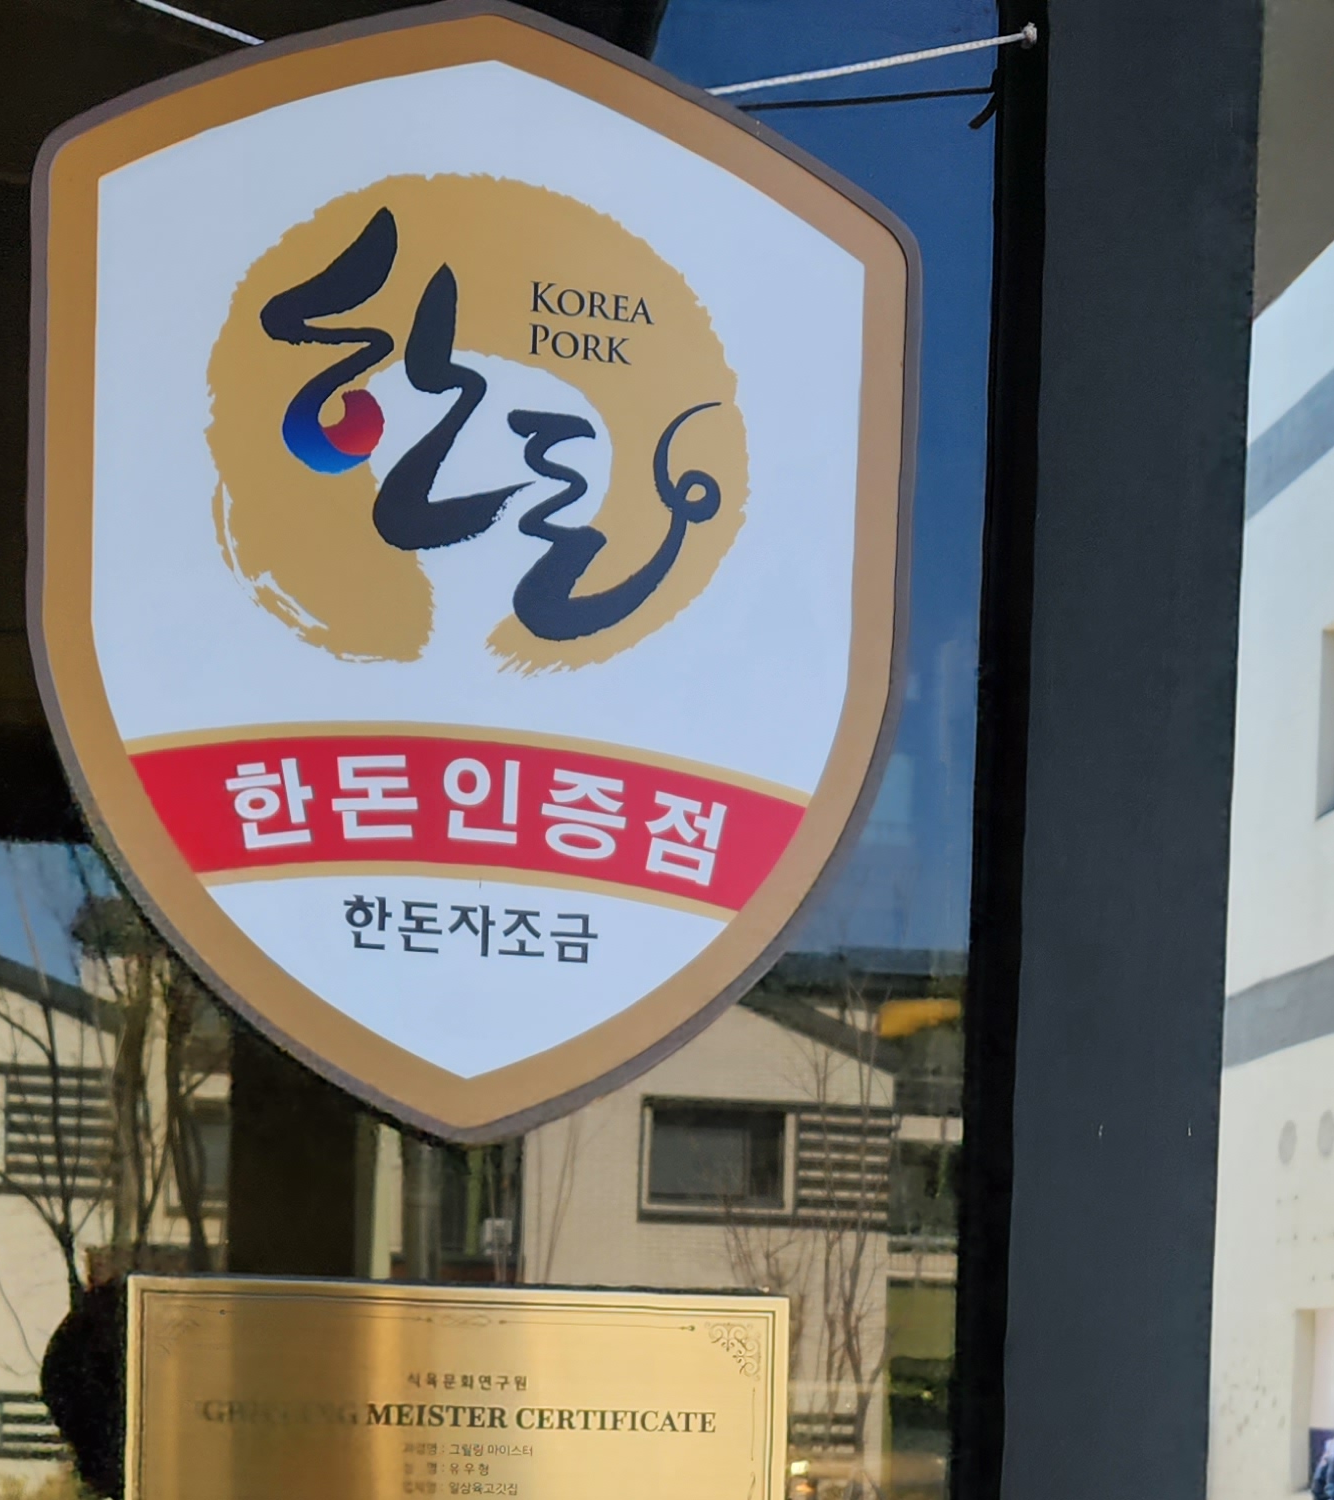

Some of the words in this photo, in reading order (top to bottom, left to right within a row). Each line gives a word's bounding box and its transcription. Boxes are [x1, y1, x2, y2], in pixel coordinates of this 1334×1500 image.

[529, 280, 655, 327] KOREA
[528, 321, 632, 367] PORK
[224, 752, 730, 888] 한돈인증점
[341, 893, 601, 967] 한돈자조금
[407, 1371, 529, 1392] 식육문화연구원
[367, 1403, 507, 1430] MEISTER
[515, 1406, 717, 1435] CERTIFICATE
[487, 1444, 534, 1457] 마이스터
